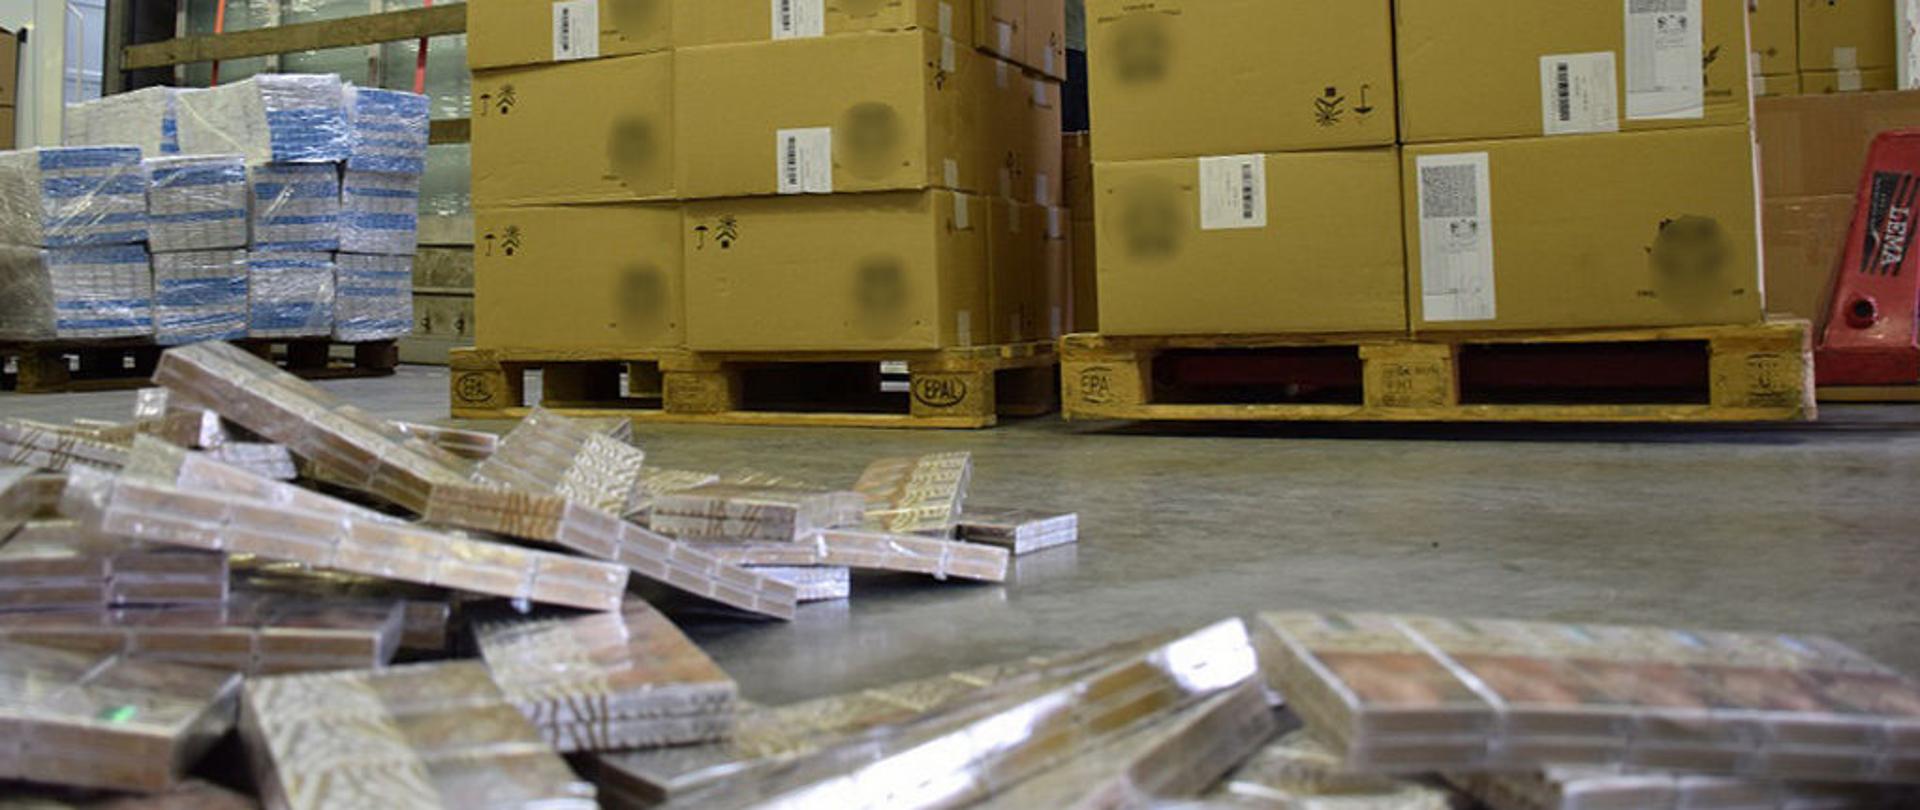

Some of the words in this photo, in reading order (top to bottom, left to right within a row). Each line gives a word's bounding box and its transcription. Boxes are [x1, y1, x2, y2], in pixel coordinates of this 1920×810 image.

[1880, 204, 1910, 265] LEMA
[924, 378, 957, 398] EPAL
[1080, 374, 1114, 396] EPA
